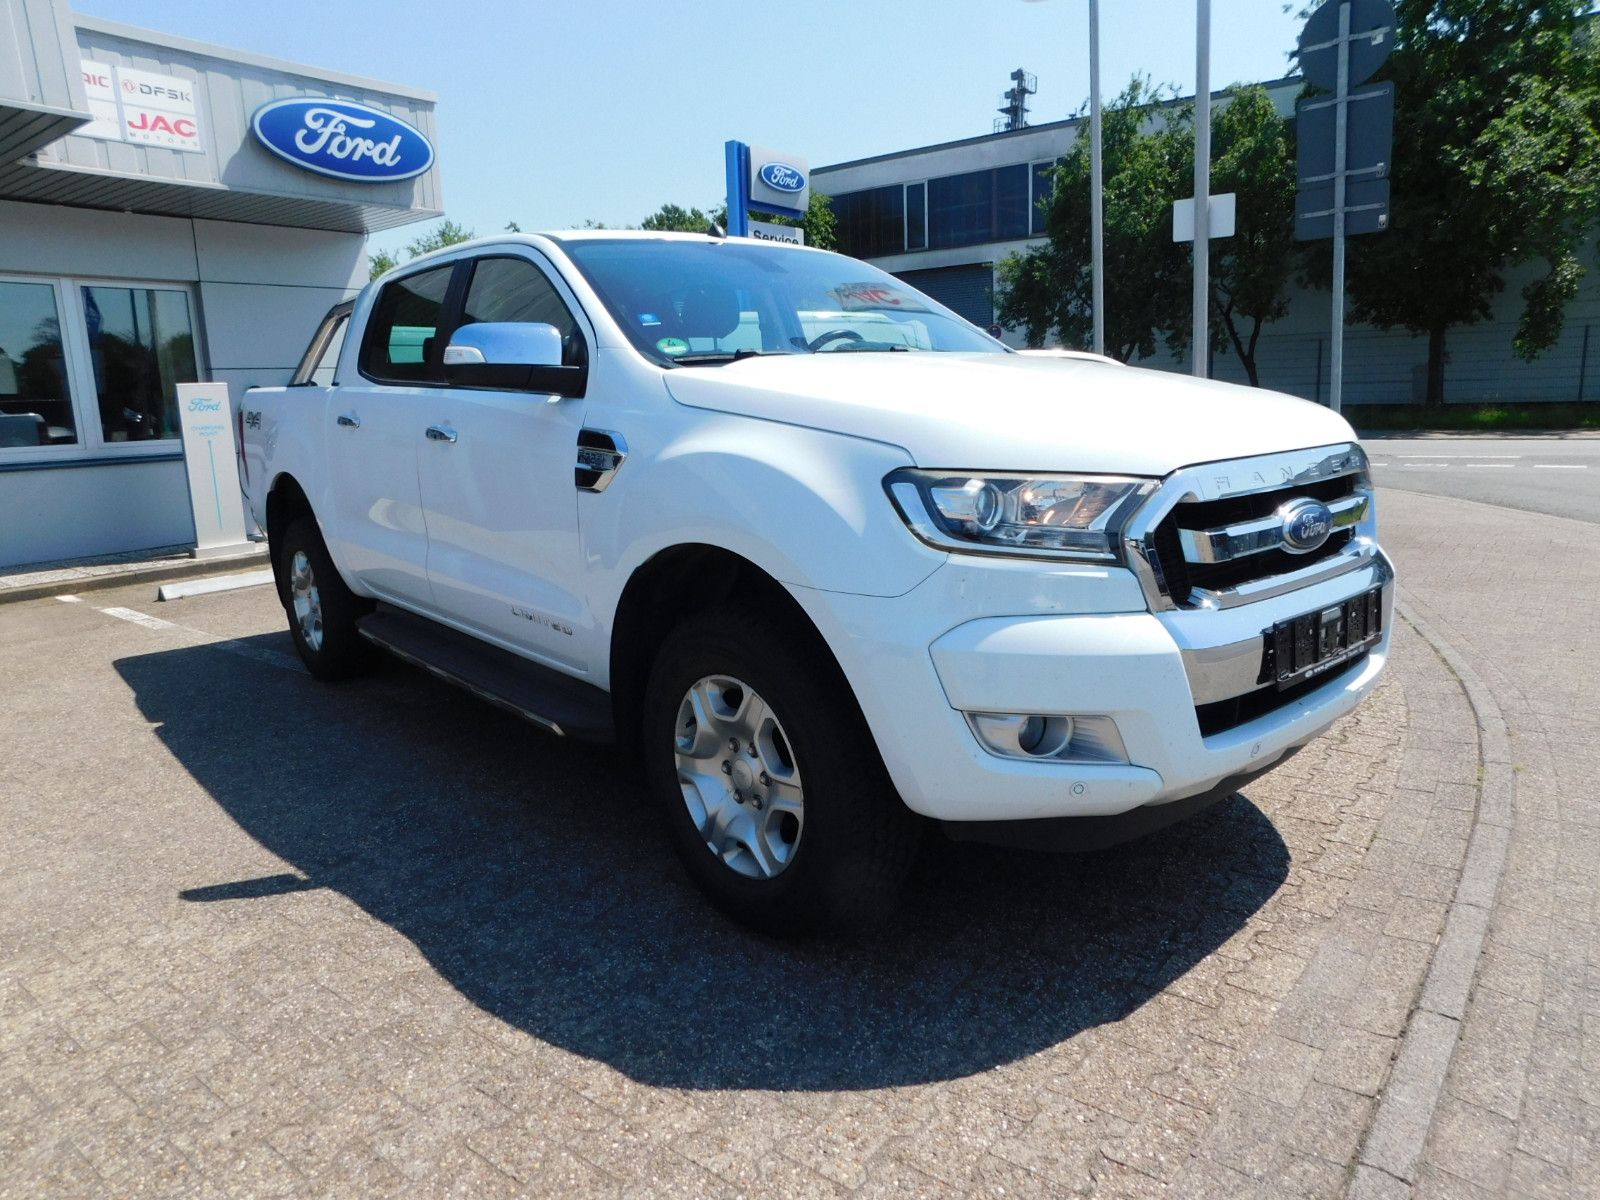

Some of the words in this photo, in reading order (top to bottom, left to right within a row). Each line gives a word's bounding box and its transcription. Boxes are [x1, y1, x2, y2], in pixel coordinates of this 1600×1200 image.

[139, 83, 192, 103] DFSK
[127, 113, 197, 137] JAC
[295, 108, 402, 167] Ford
[771, 165, 799, 188] Ford
[188, 397, 222, 412] Ford
[1302, 513, 1326, 539] Ford
